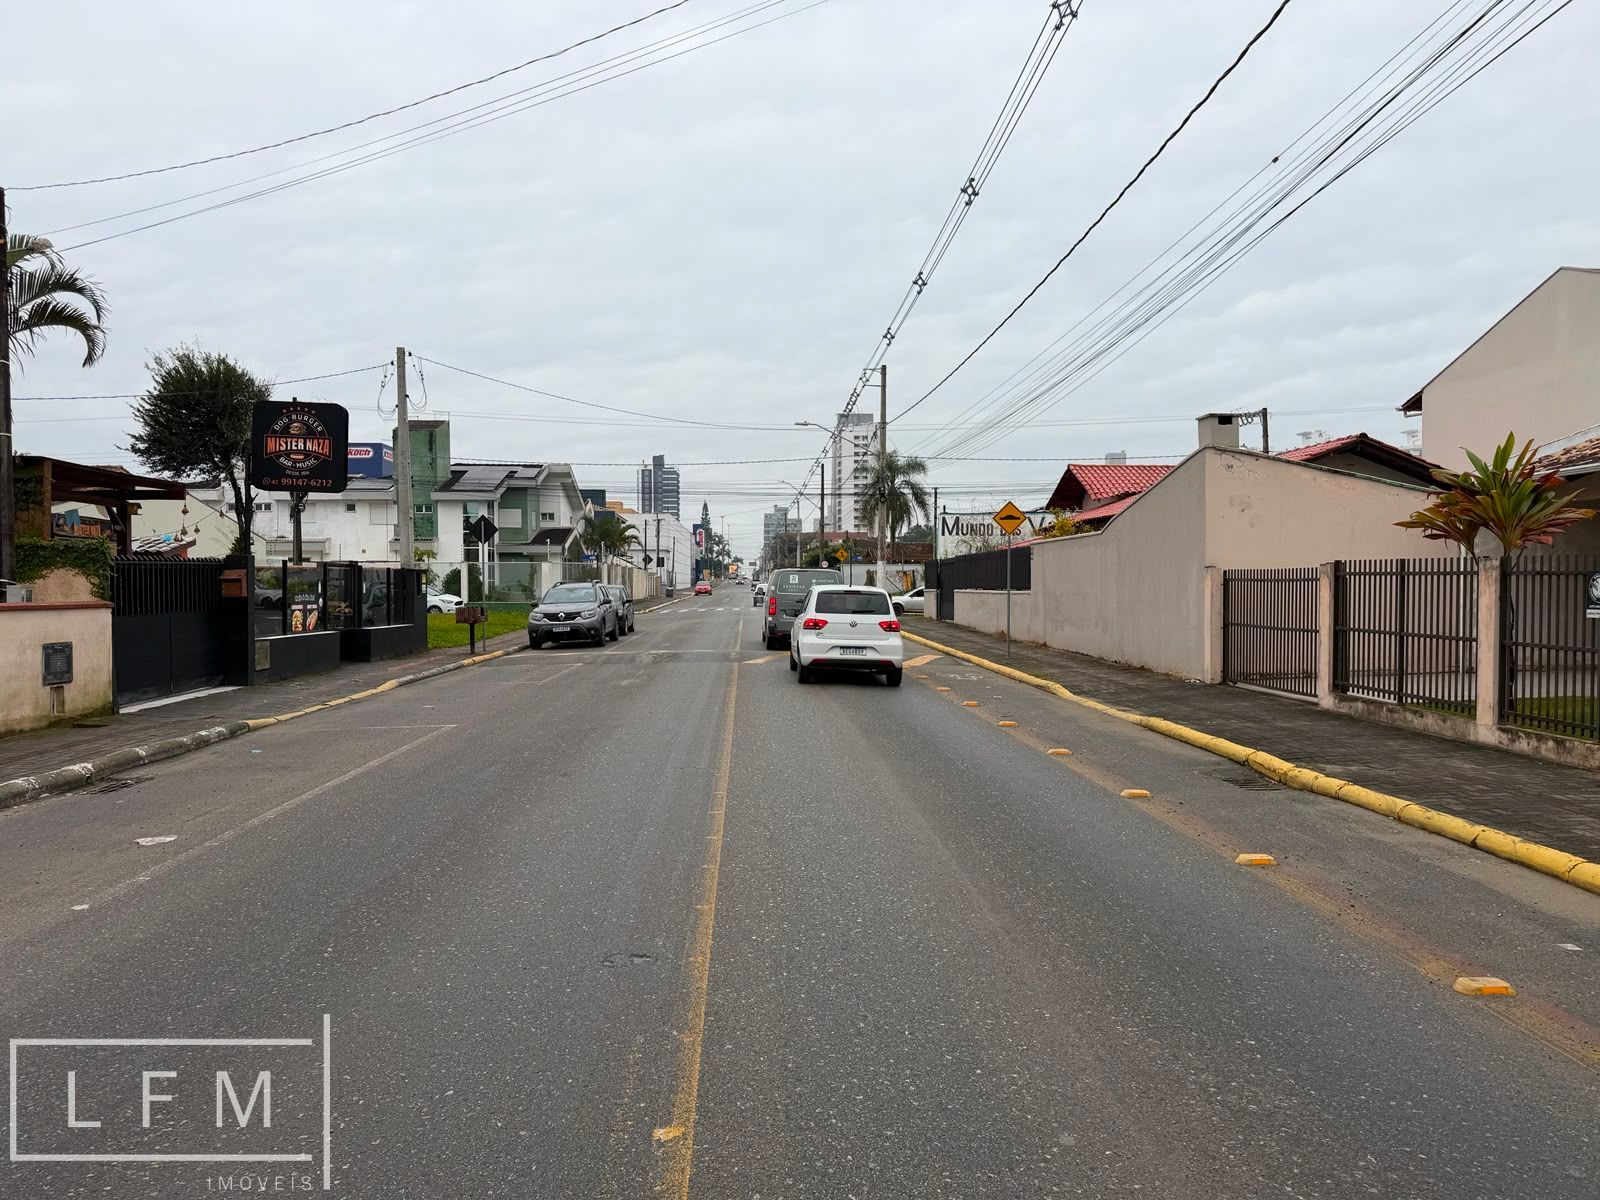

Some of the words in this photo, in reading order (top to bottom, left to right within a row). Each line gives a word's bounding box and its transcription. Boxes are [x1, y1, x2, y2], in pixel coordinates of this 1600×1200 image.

[273, 416, 289, 431] DOG
[291, 414, 324, 432] BURGER
[267, 437, 304, 454] MISTER
[306, 438, 329, 456] NAZA
[279, 456, 293, 467] BAR
[296, 457, 318, 469] MUSIC
[280, 477, 333, 487] 99147-6212
